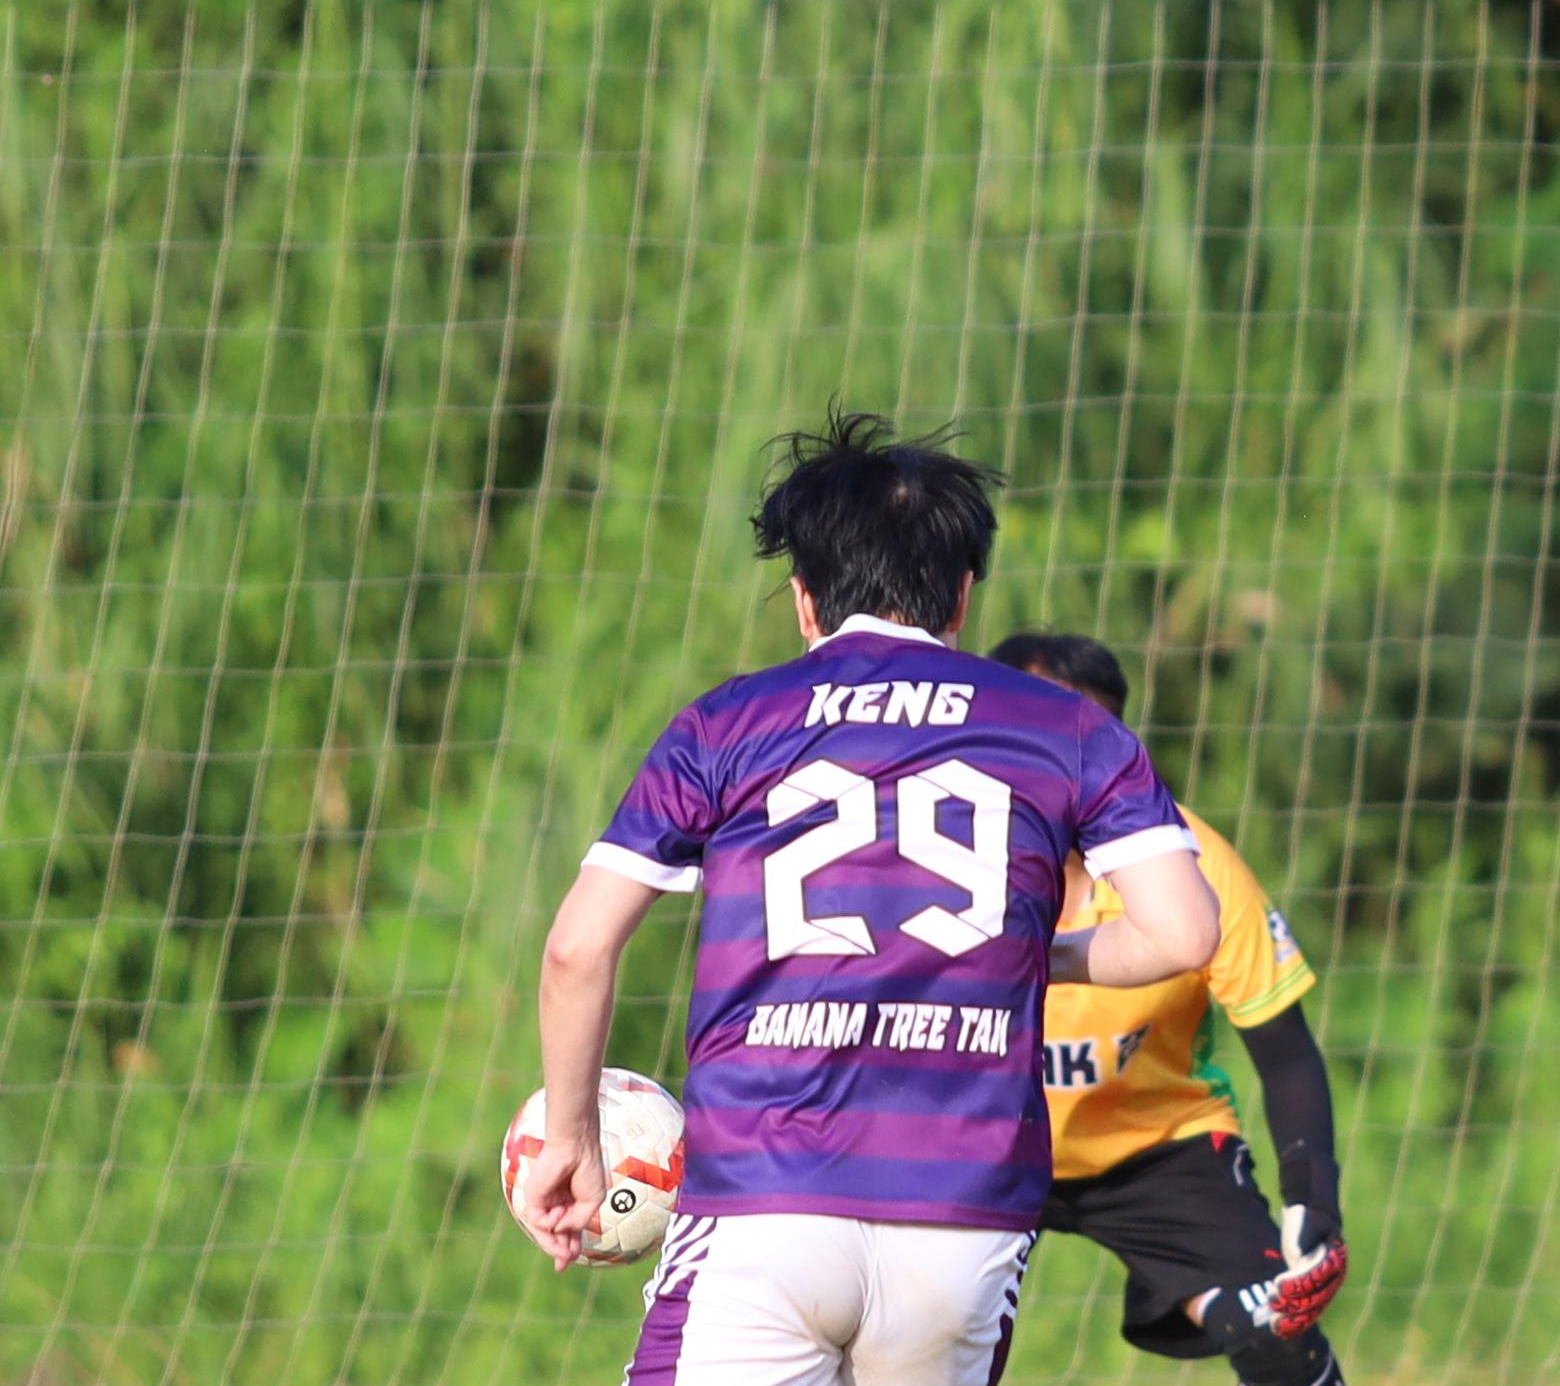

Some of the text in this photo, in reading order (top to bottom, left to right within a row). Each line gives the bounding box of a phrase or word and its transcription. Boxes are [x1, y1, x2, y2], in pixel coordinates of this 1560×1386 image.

[804, 680, 975, 729] KENG
[764, 758, 1012, 961] 29
[745, 1001, 868, 1050] BANANA
[872, 1002, 952, 1052] TREE
